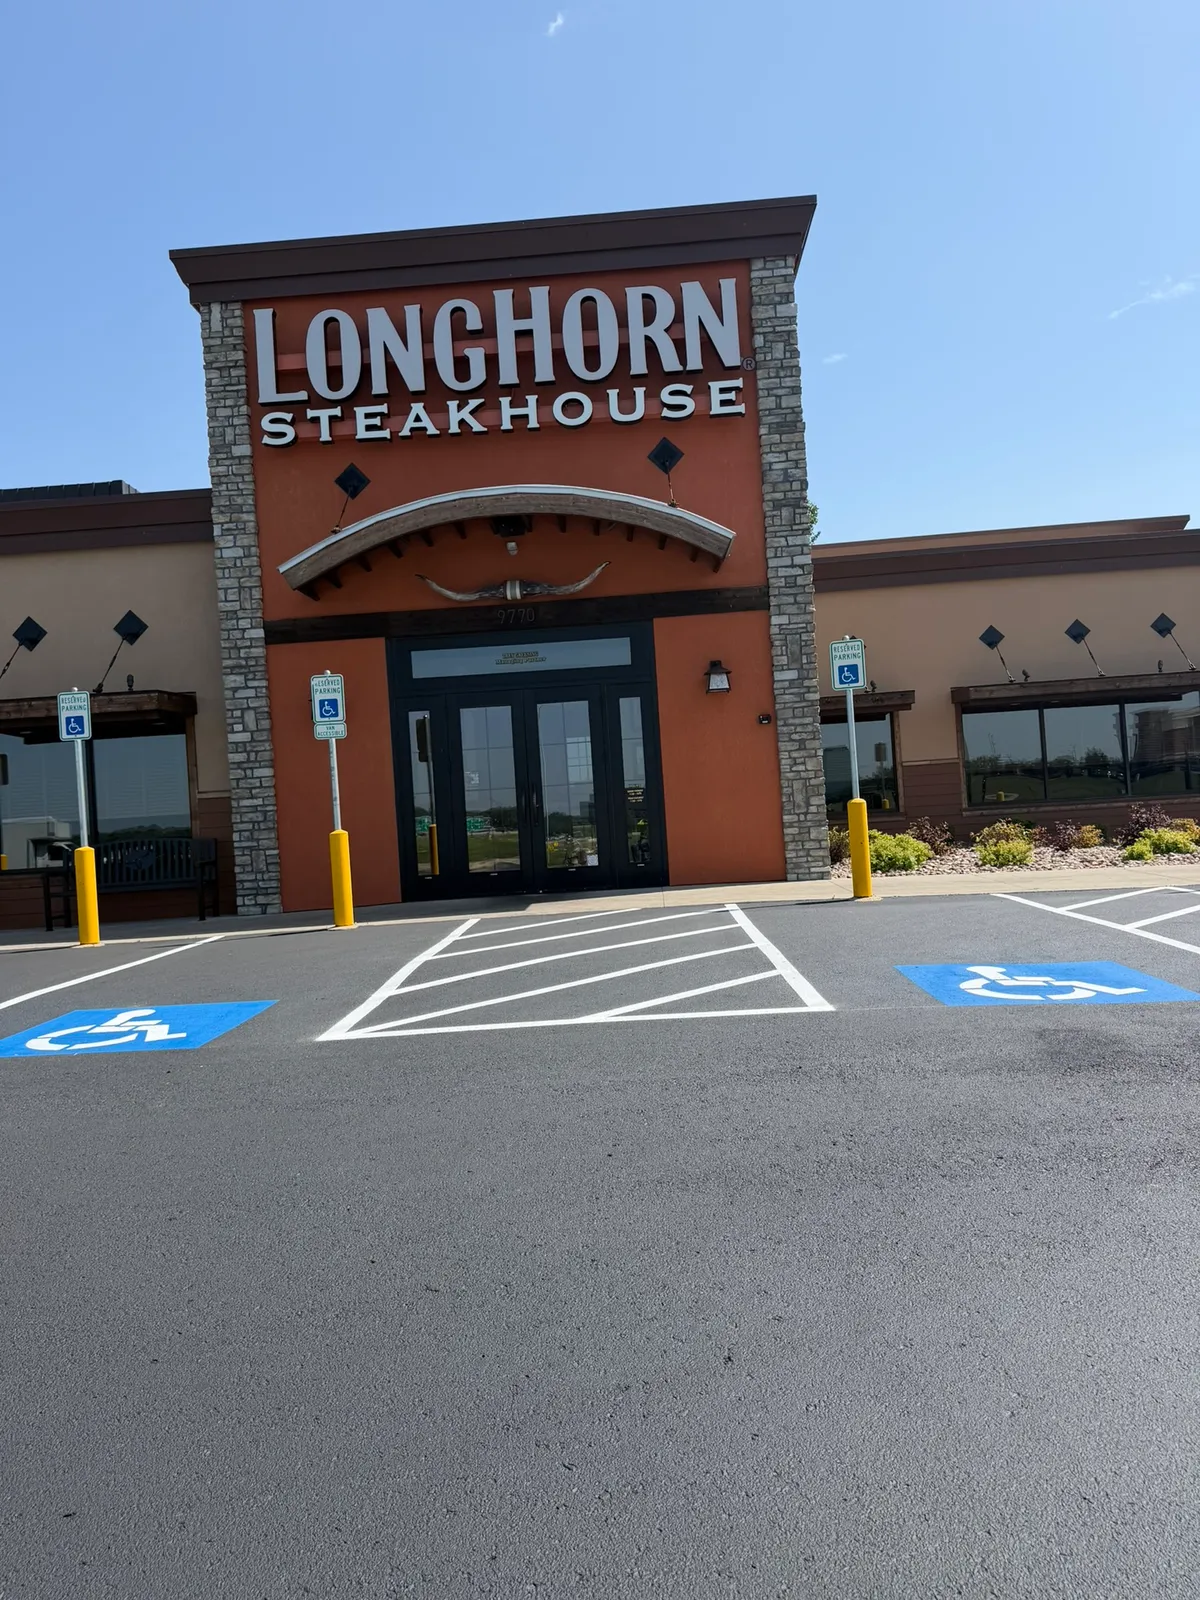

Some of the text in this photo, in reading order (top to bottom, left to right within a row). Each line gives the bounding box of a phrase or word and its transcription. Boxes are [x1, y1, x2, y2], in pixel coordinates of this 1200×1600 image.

[252, 277, 741, 404] LONGHORN
[261, 377, 746, 447] STEAKHOUSE
[497, 608, 535, 624] 9770
[833, 645, 860, 653] RESERVED
[834, 653, 861, 661] PARKING
[315, 679, 340, 687] RESERVED
[315, 687, 340, 695] PARKING
